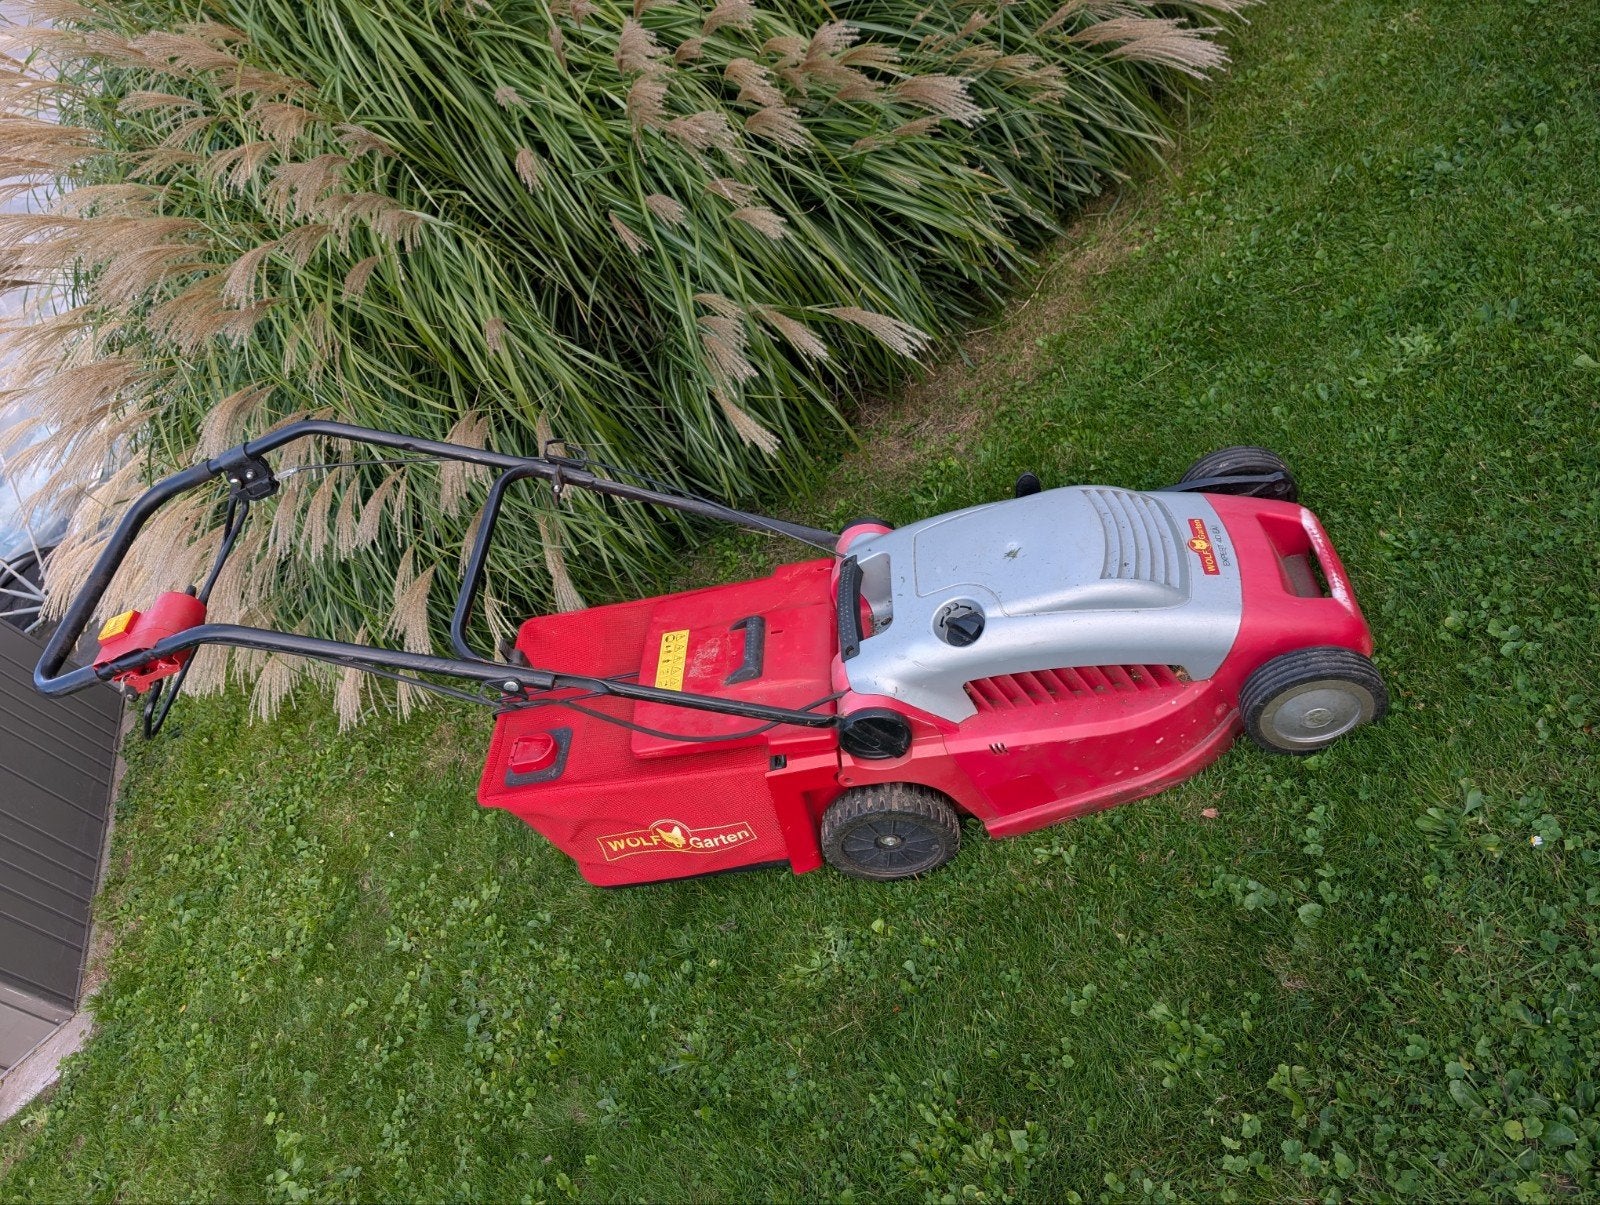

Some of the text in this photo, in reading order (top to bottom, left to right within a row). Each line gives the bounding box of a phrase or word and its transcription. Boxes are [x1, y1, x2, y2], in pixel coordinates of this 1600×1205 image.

[1194, 519, 1216, 572] WOLF Garten
[1217, 544, 1231, 567] EXPERT
[606, 830, 750, 852] WOLF Garten
